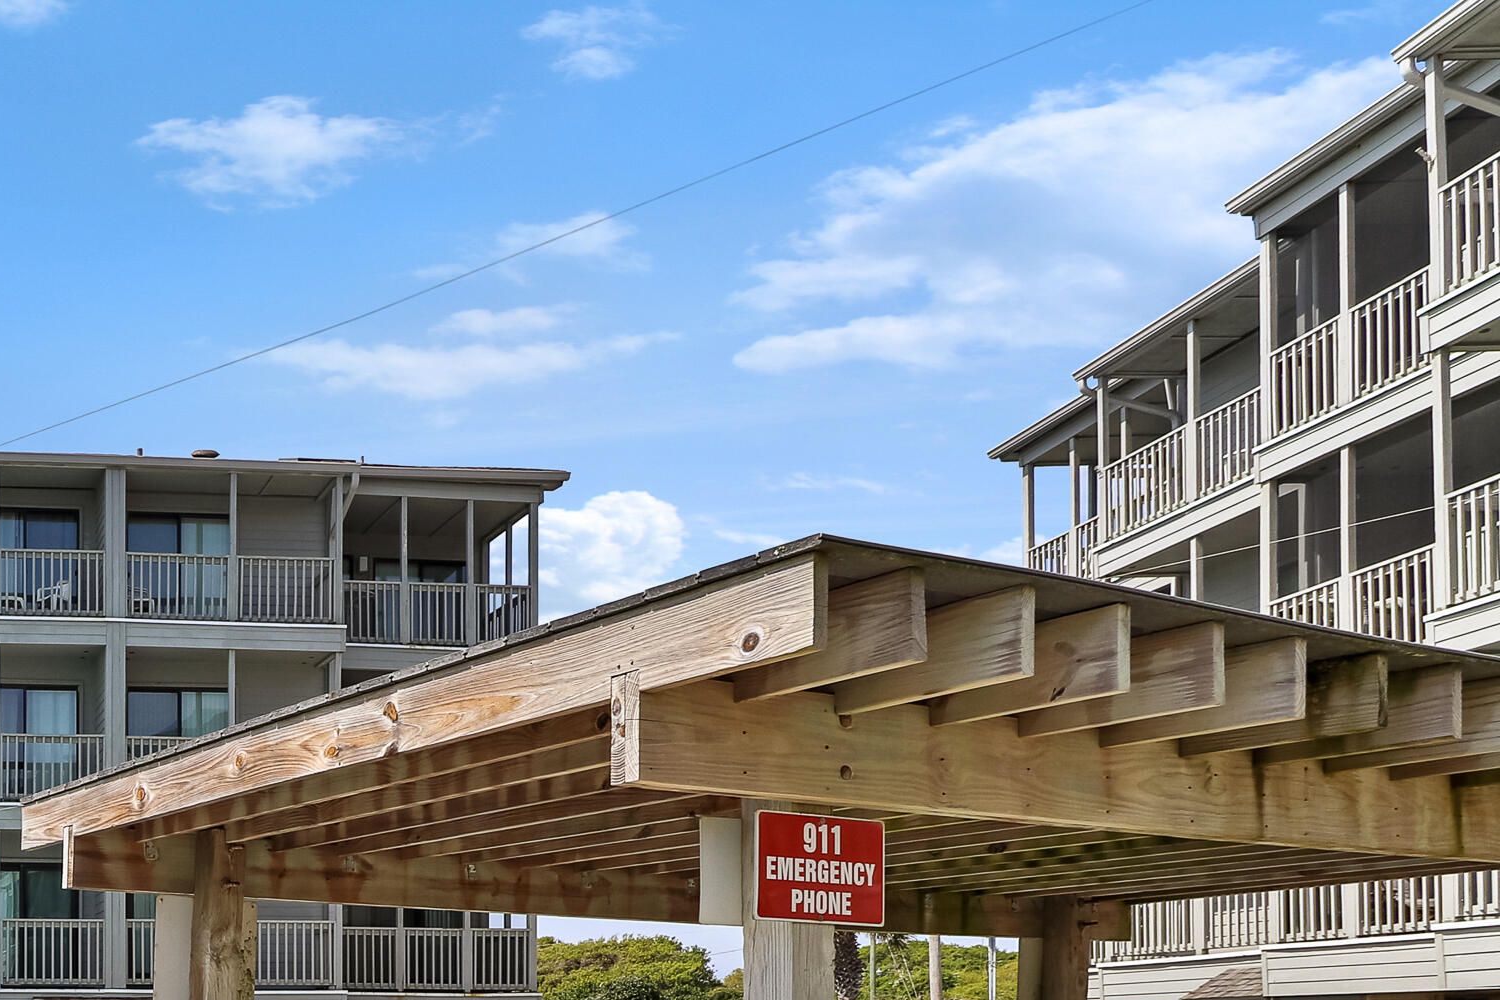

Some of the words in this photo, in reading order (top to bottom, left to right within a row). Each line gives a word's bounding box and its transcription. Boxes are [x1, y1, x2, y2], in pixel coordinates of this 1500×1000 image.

[803, 822, 841, 855] 911
[766, 855, 876, 887] EMERGENCY
[791, 888, 852, 916] PHONE
